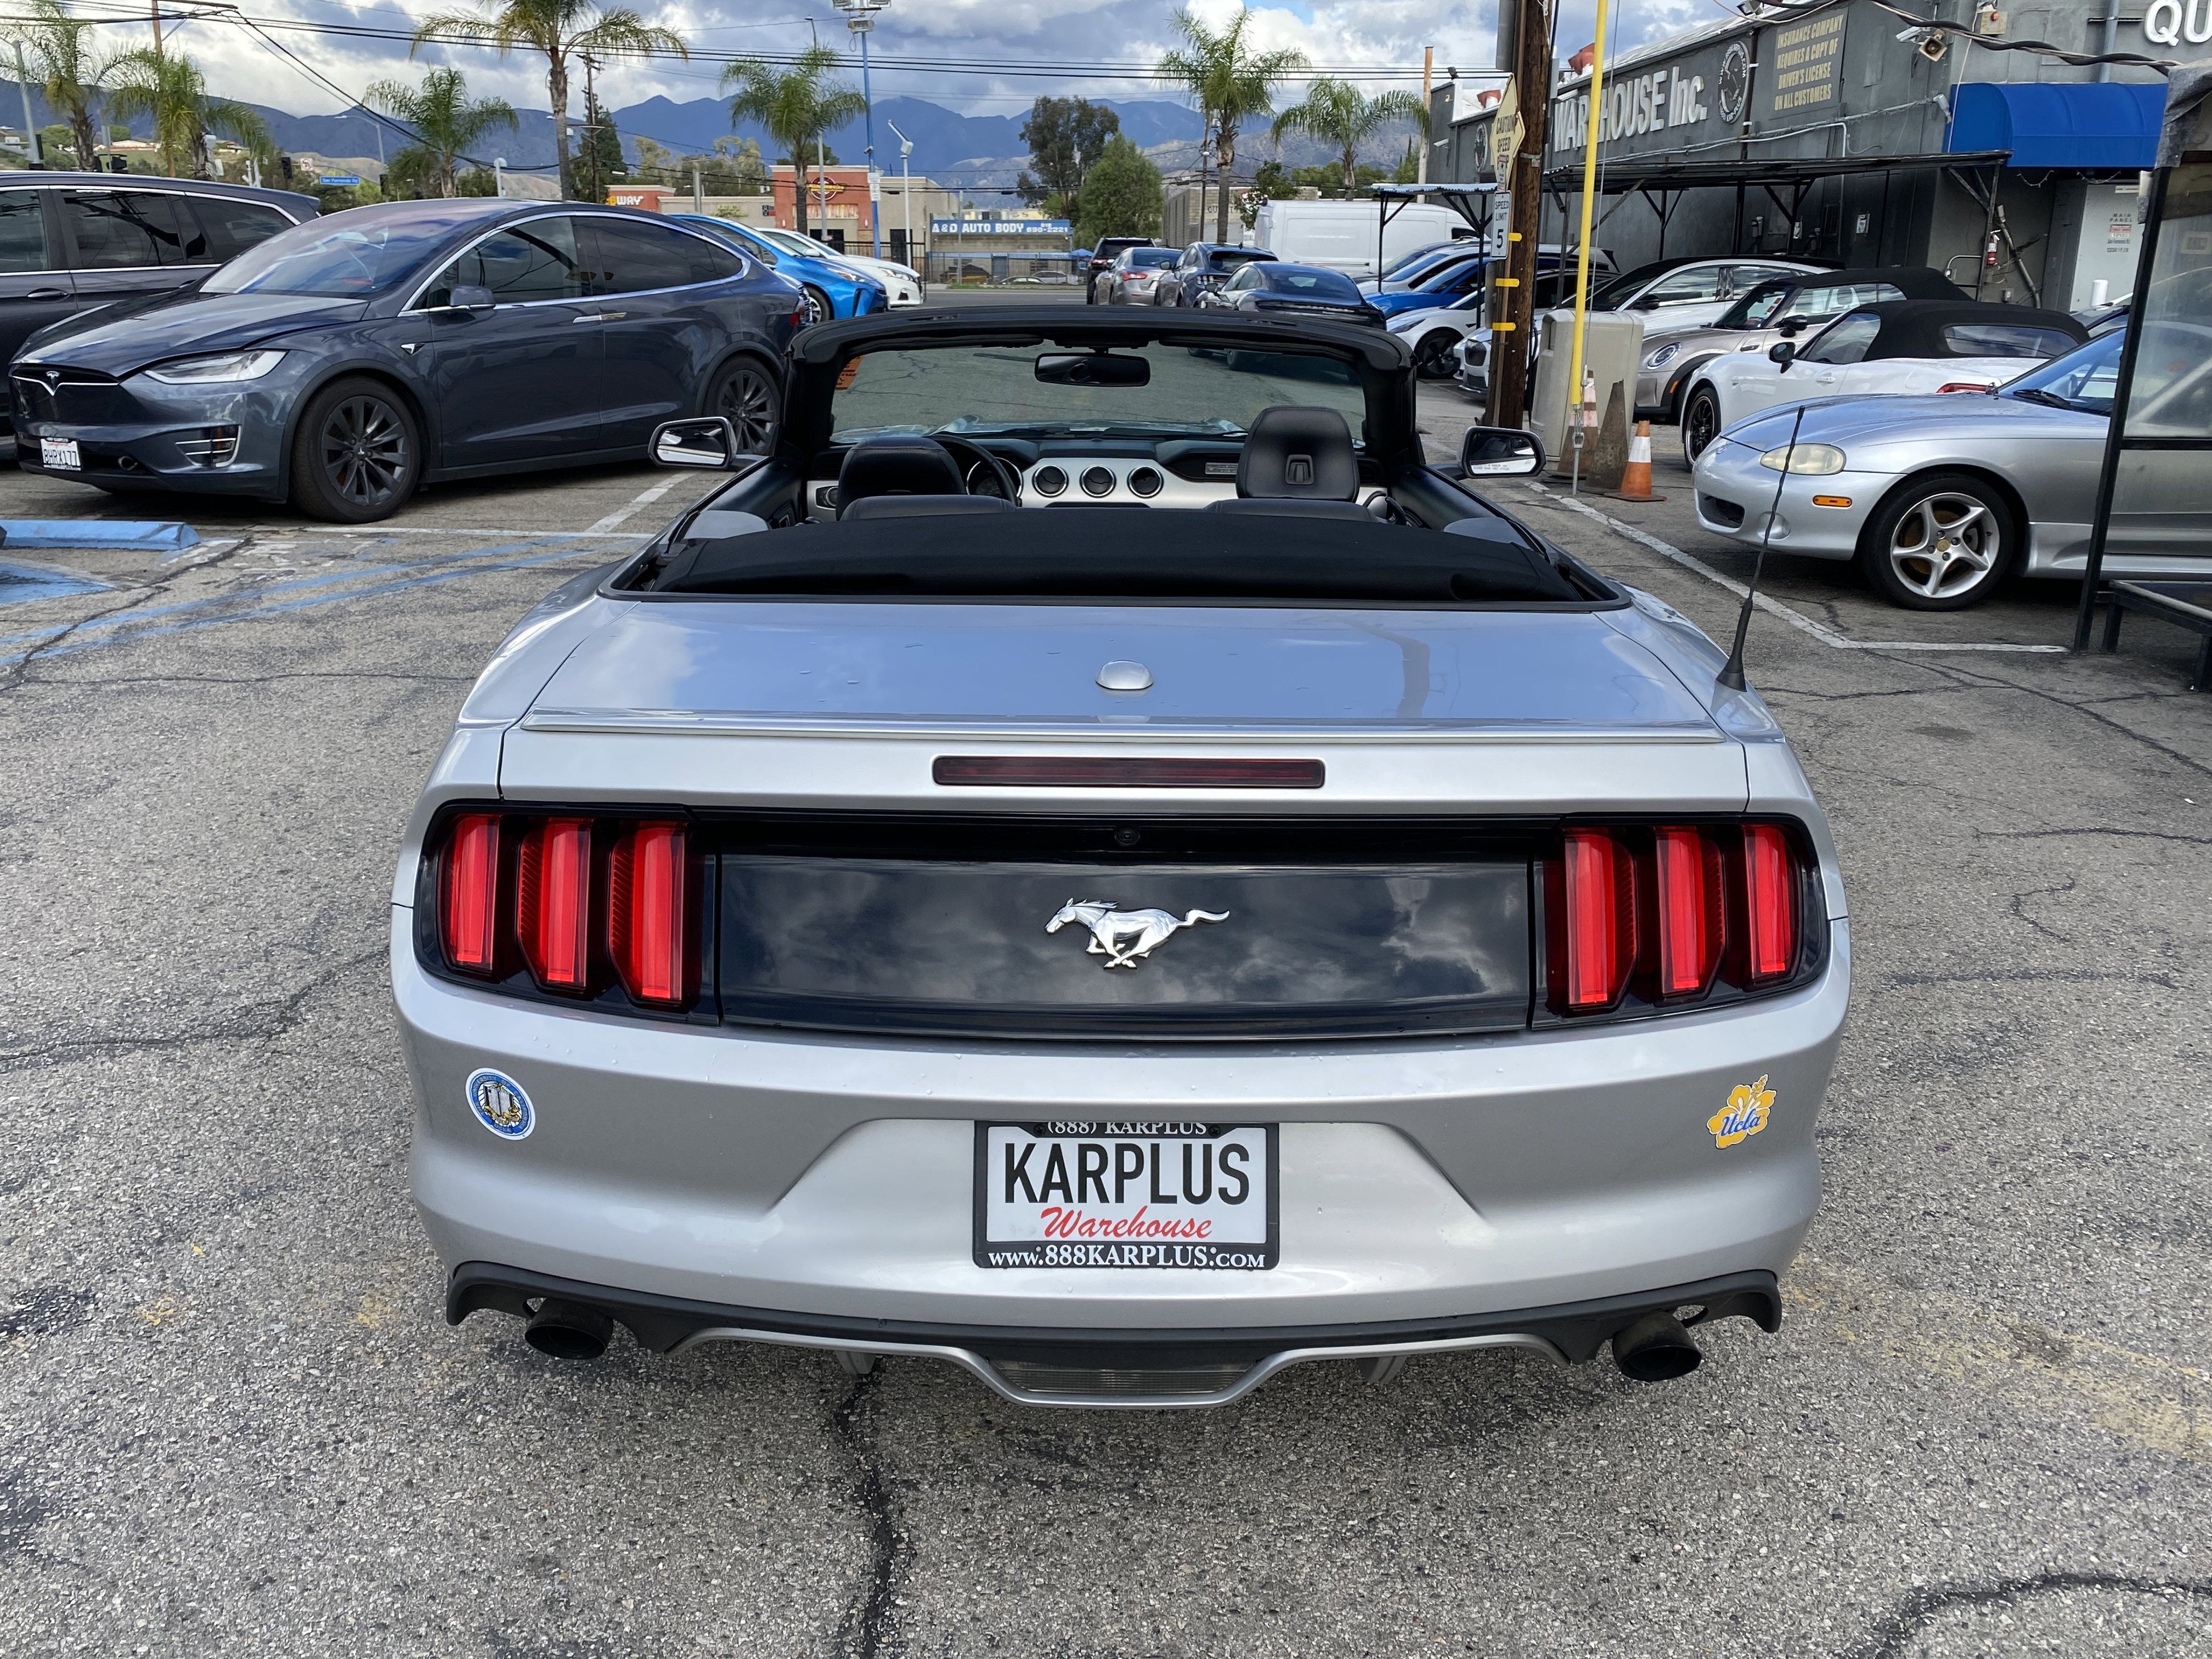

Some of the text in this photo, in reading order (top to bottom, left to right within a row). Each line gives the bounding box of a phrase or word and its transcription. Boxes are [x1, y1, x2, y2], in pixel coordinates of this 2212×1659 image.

[1777, 14, 1844, 49] INSURANCE COMPANY
[1777, 38, 1838, 70] REQUIRES A COPY OF
[1779, 61, 1832, 89] DRIVER'S LICENSE
[1555, 70, 1667, 152] WARHOUSE
[1669, 66, 1708, 127] Inc.
[1775, 83, 1832, 111] ON ALL CUSTOMERS
[1498, 137, 1511, 153] SPEED
[1495, 201, 1509, 210] SPEED
[1496, 212, 1508, 221] LIMIT
[962, 223, 991, 233] AUTO
[995, 223, 1024, 233] BODY
[1497, 229, 1504, 249] 5
[1047, 1122, 1207, 1135] (888) KARPLUS
[1005, 1143, 1250, 1205] KARPLUS
[1041, 1205, 1212, 1239] Warehouse
